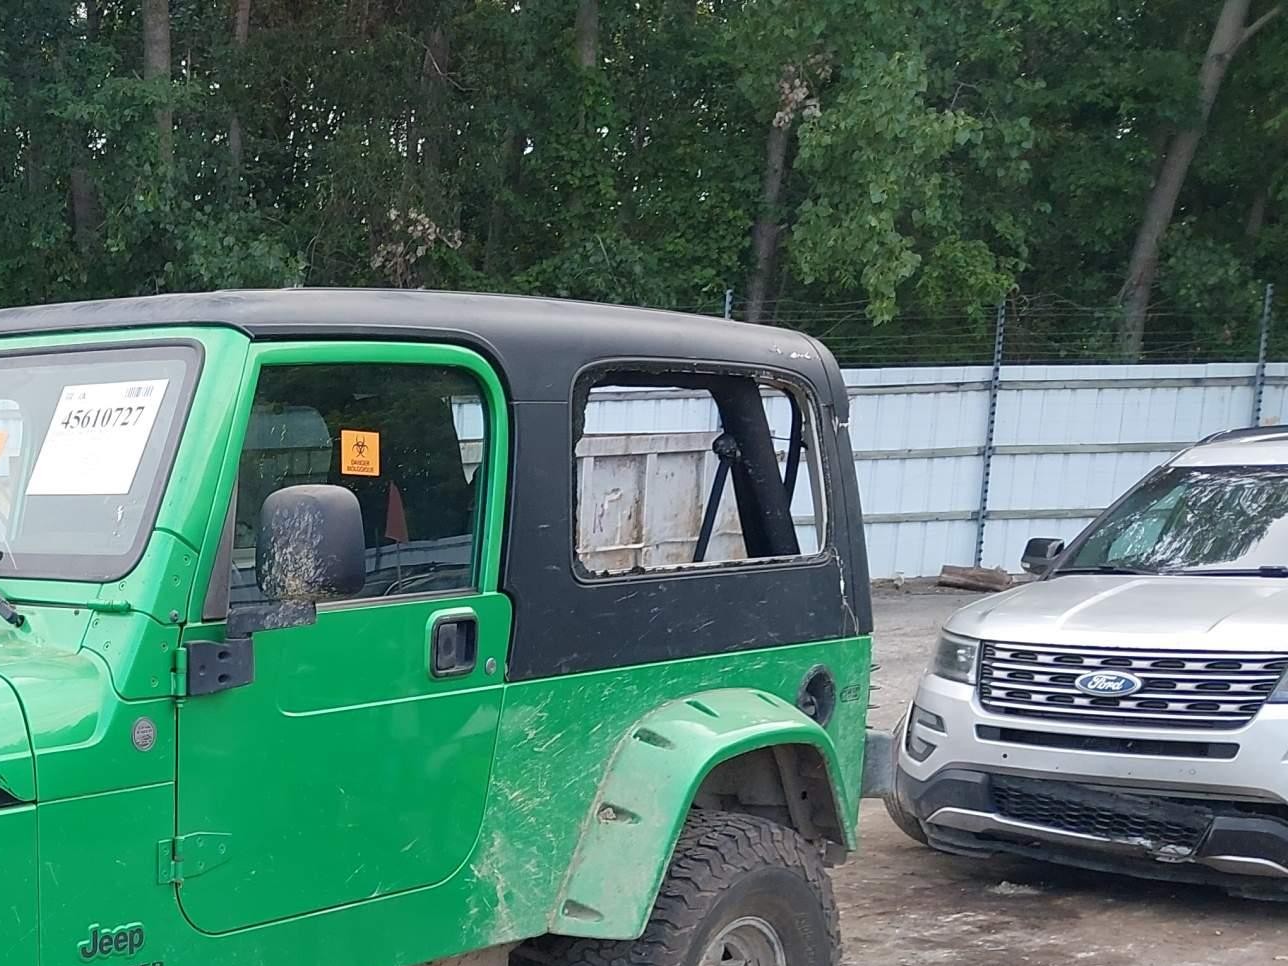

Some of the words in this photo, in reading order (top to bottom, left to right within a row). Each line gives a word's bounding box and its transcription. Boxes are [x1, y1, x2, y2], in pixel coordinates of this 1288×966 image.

[61, 405, 145, 430] 45610727
[1087, 675, 1126, 690] Ford
[78, 925, 144, 959] Jeep
